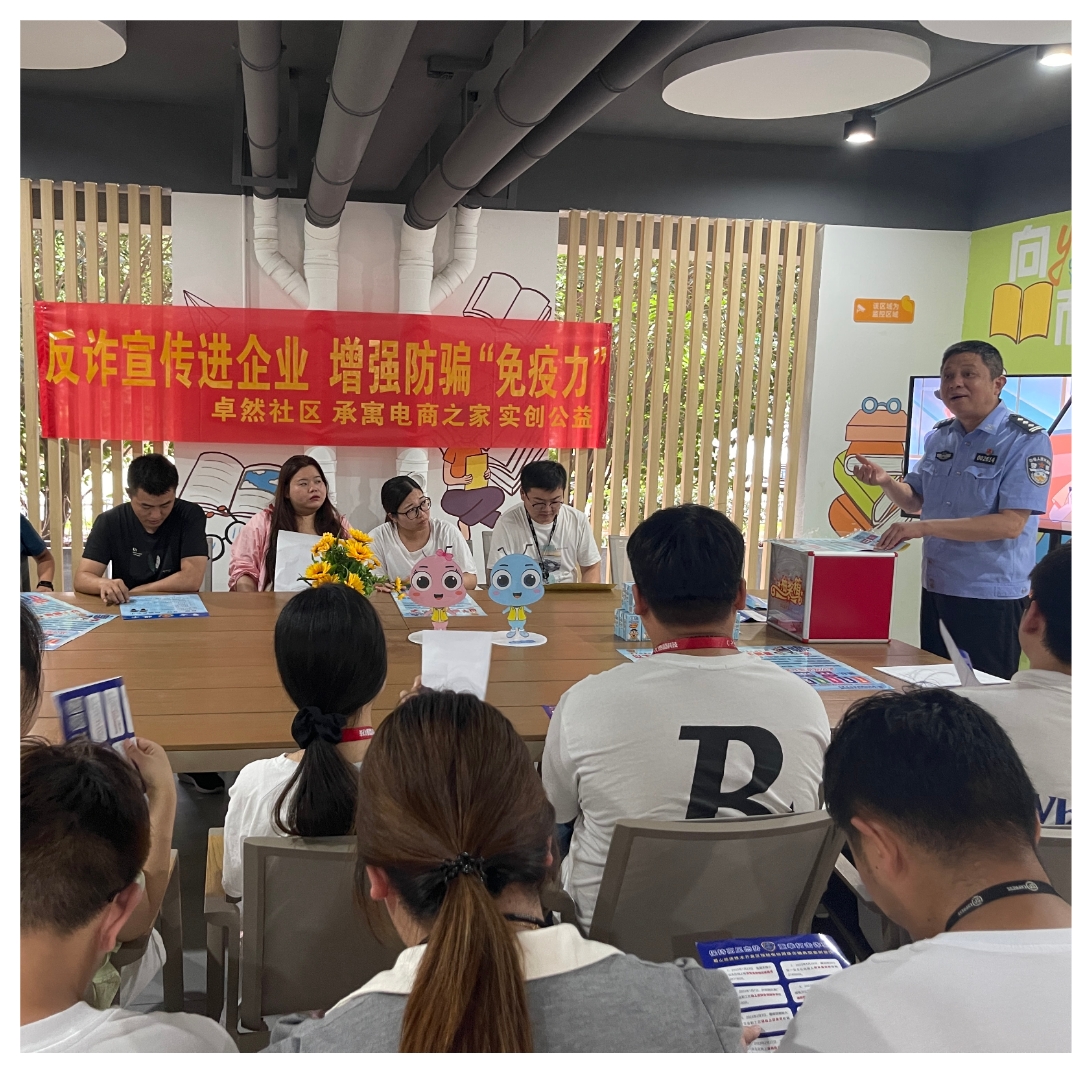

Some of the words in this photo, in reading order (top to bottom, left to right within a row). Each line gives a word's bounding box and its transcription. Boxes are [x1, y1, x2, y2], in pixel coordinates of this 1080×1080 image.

[1009, 225, 1051, 282] 向
[45, 328, 309, 391] 反诈宣传进企业
[329, 336, 609, 399] 增强防骗“免疫力”
[210, 396, 323, 425] 卓然社区
[332, 401, 492, 428] 承寓电商之家
[498, 403, 595, 430] 实创公益
[678, 725, 783, 819] R
